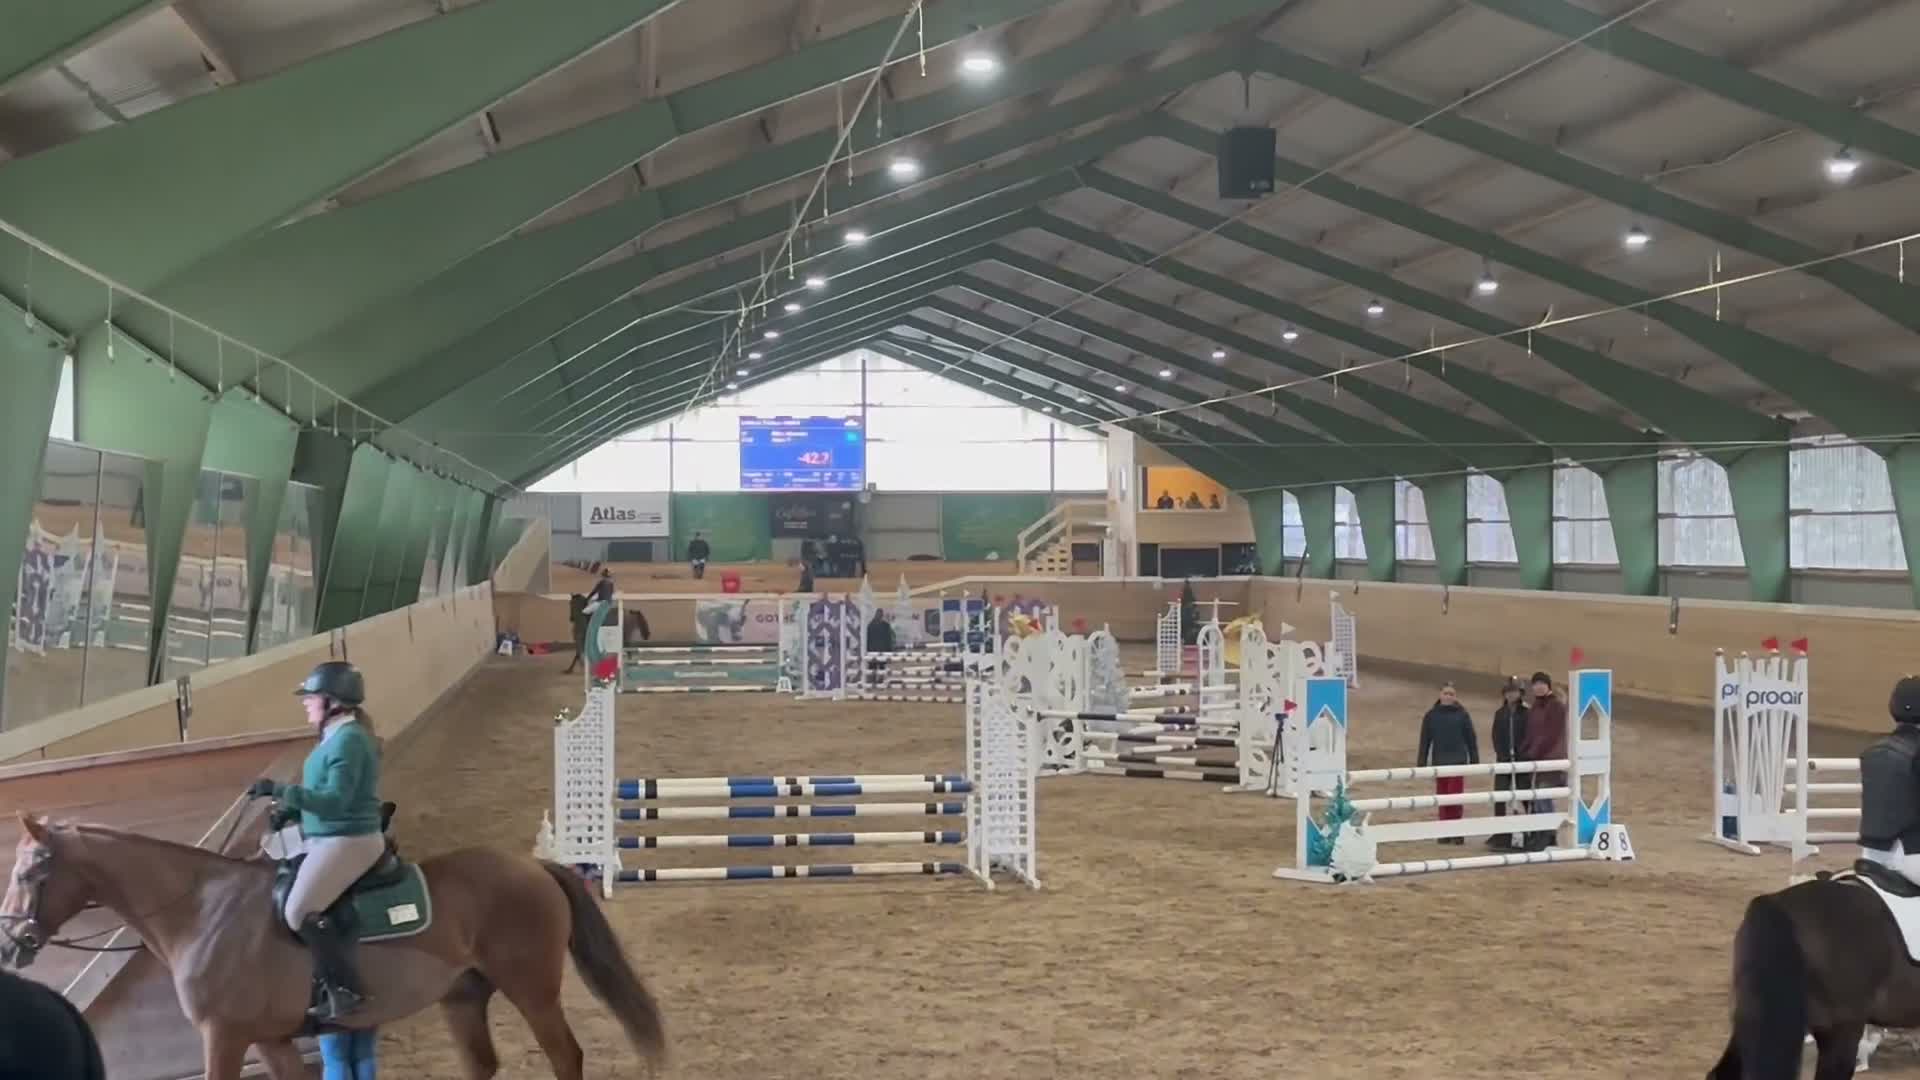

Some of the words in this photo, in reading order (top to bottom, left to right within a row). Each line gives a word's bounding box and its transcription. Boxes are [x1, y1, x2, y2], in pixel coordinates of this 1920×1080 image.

[590, 506, 637, 521] Atlas
[1745, 690, 1804, 709] proair
[1597, 831, 1610, 851] 8
[1618, 831, 1629, 851] 8
